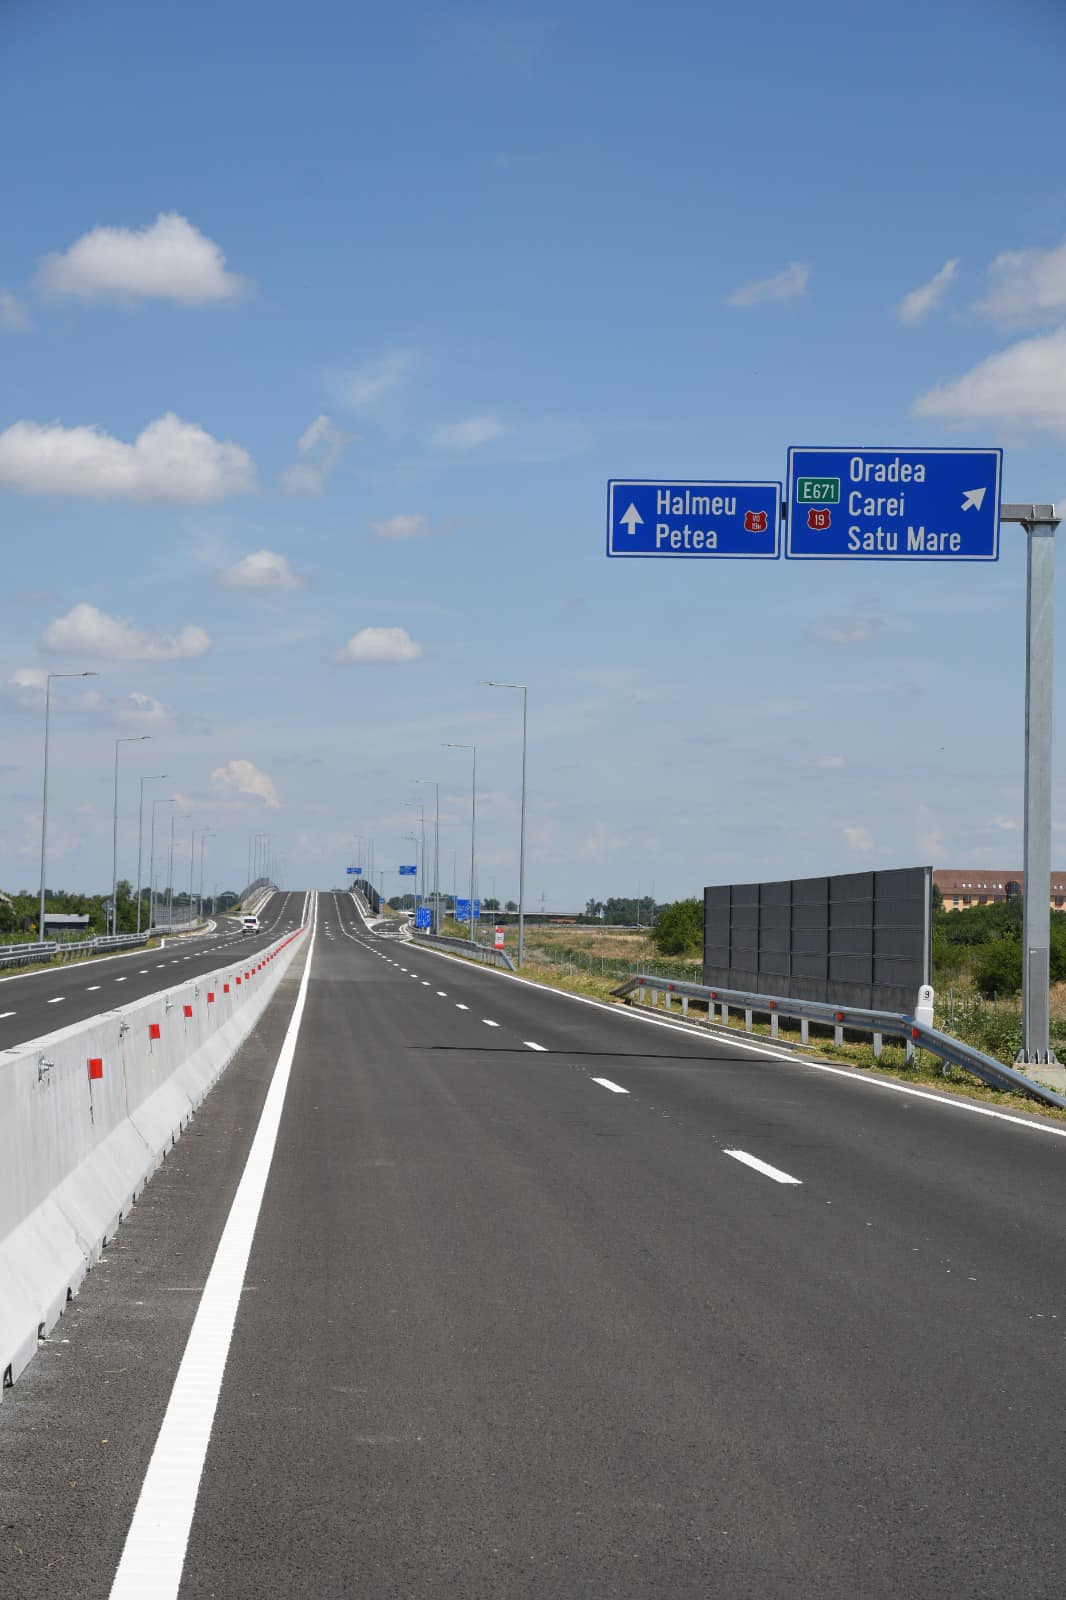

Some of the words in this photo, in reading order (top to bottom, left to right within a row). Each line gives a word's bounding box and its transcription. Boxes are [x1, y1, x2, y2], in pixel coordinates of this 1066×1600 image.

[850, 457, 926, 483] Oradea
[657, 490, 736, 516] Halmeu
[803, 482, 835, 499] E671
[849, 491, 905, 517] Carei
[815, 514, 825, 526] 19
[656, 524, 718, 549] Petea
[848, 526, 898, 551] Satu
[907, 526, 961, 551] Mare
